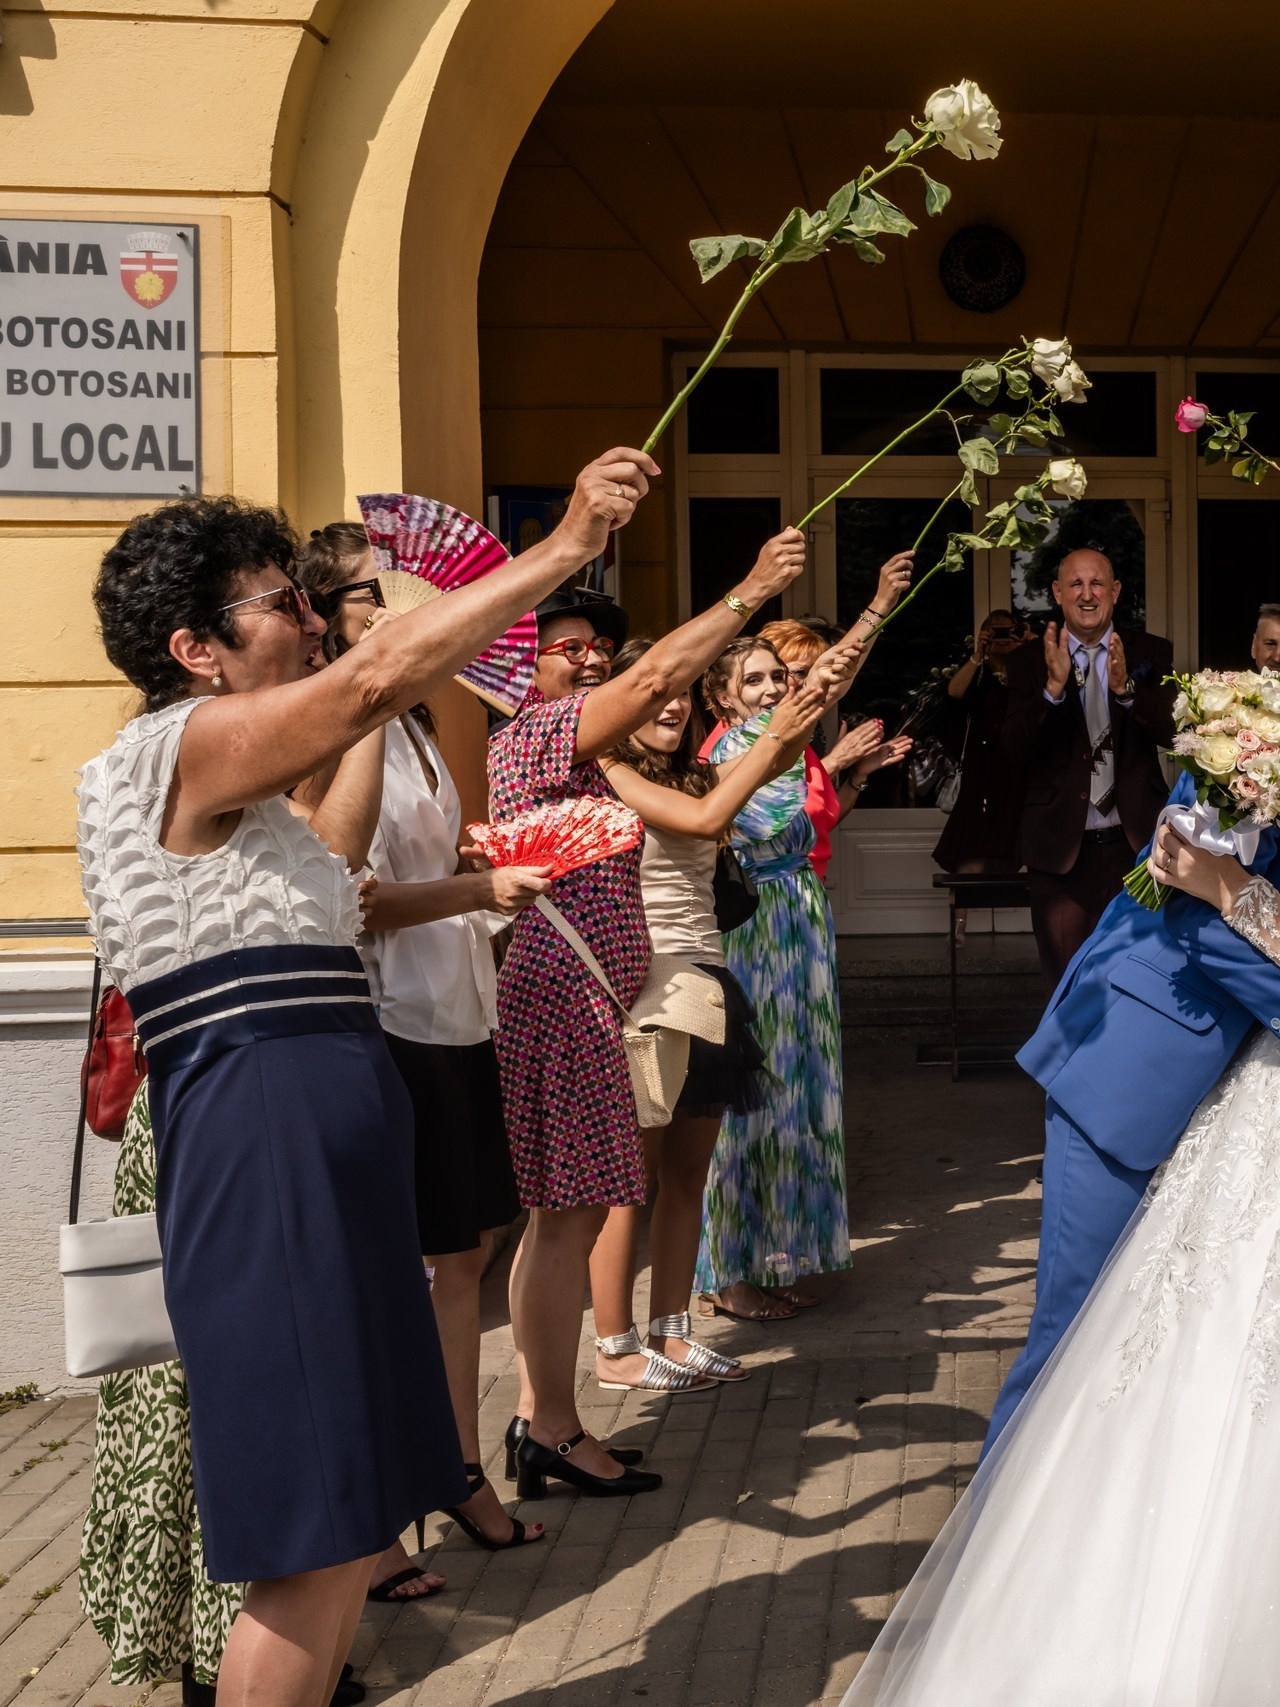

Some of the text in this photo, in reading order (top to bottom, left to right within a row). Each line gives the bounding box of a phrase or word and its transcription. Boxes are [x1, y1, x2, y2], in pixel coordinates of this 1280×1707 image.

[0, 316, 186, 350] OTOSANI
[6, 369, 192, 399] BOTOSANI
[32, 422, 194, 471] LOCAL
